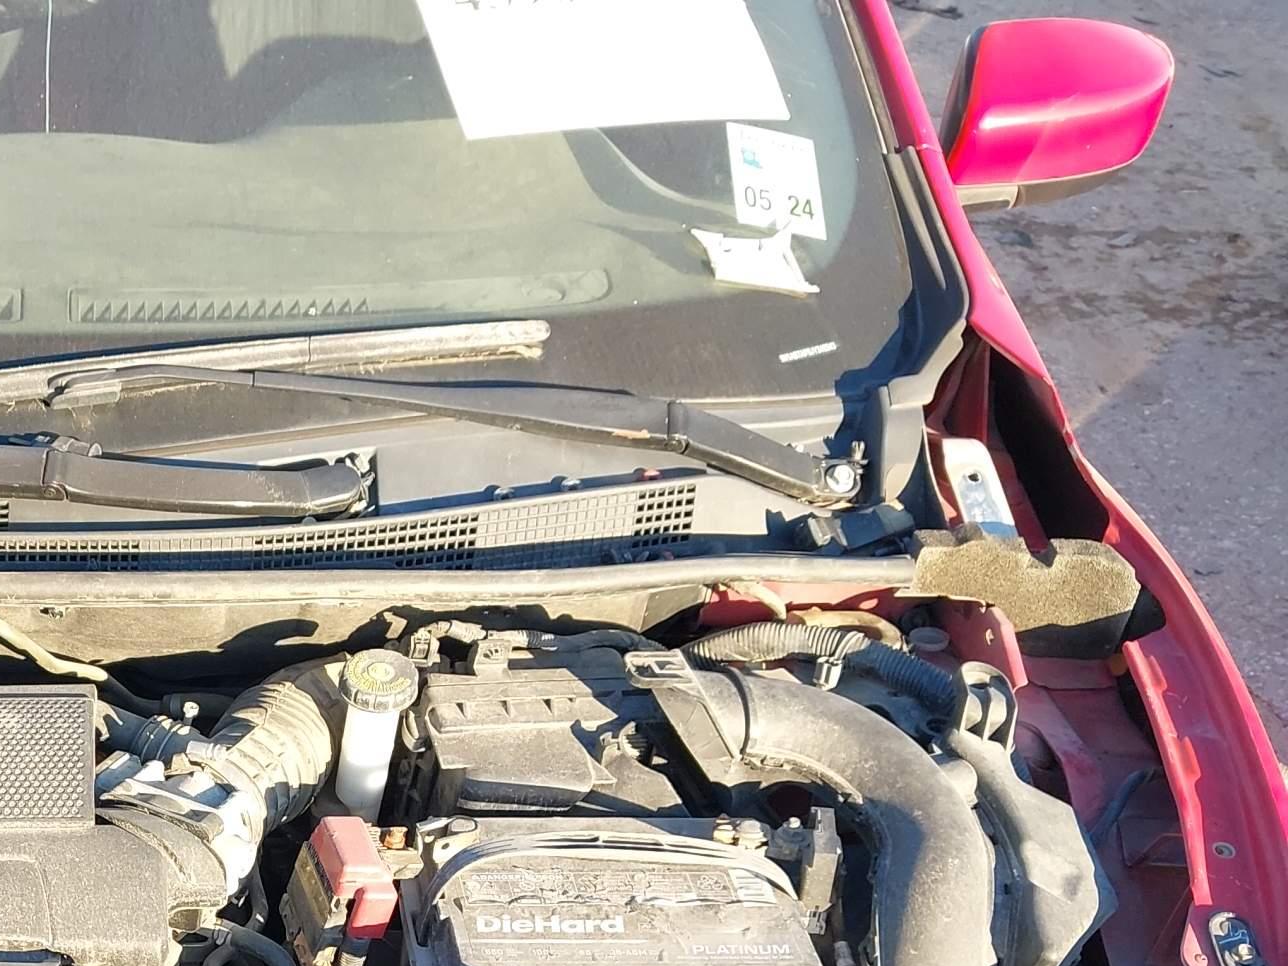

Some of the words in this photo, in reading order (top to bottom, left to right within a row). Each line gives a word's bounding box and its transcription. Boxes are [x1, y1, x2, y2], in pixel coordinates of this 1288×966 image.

[744, 186, 772, 210] 05
[787, 195, 814, 220] 24
[476, 914, 625, 933] DieHard
[691, 944, 792, 955] PLATINUM
